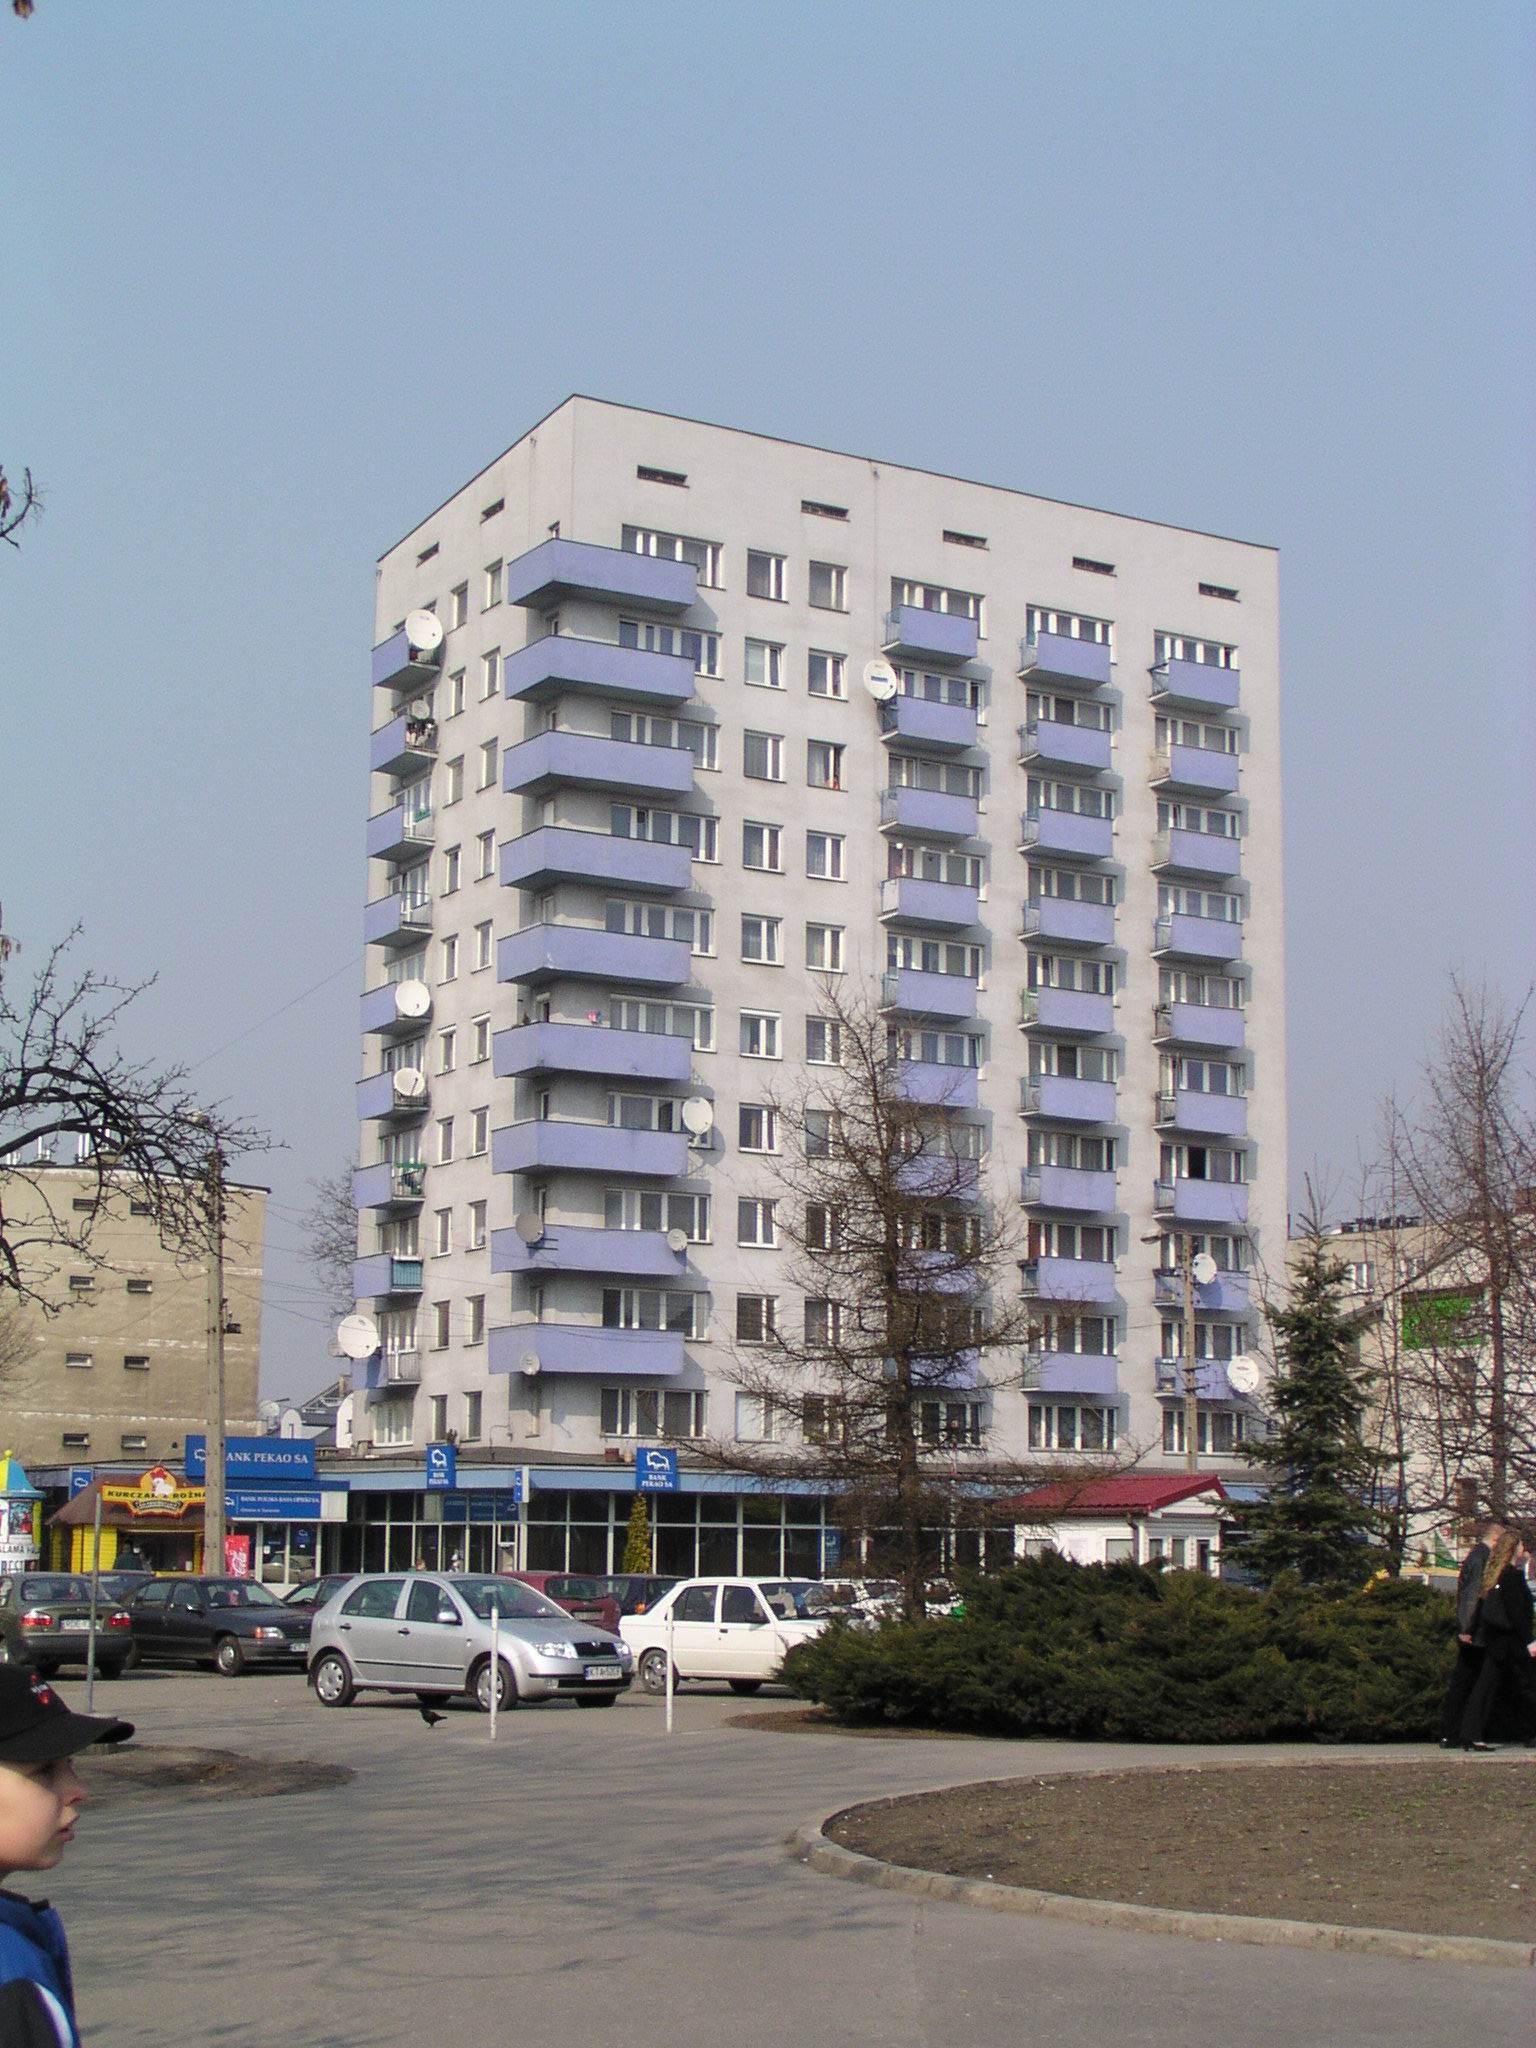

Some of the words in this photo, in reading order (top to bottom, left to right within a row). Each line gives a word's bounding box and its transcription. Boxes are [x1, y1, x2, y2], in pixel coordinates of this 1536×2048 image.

[226, 1452, 251, 1462] ANK
[254, 1452, 292, 1464] PEKAO
[293, 1454, 309, 1464] SA
